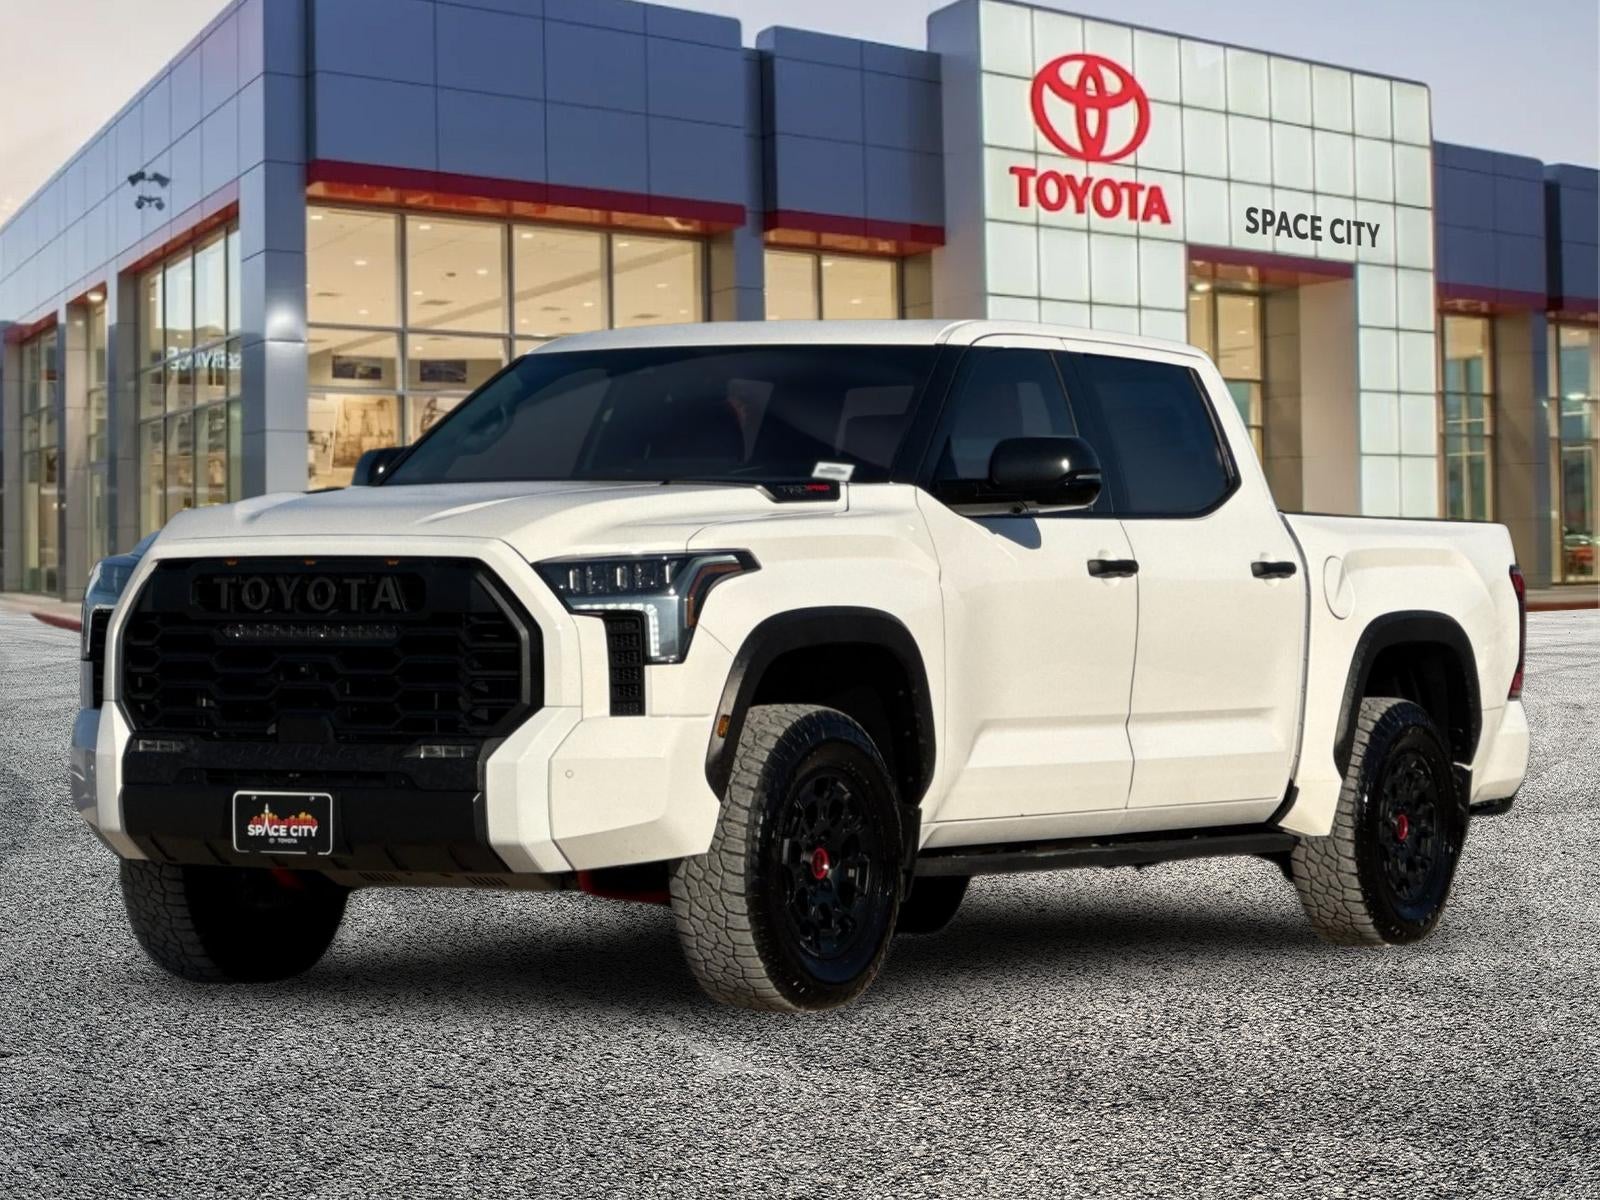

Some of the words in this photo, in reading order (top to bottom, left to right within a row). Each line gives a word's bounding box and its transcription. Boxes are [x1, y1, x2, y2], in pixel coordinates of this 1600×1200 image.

[1009, 166, 1171, 224] TOYOTA
[1245, 207, 1322, 242] SPACE
[1330, 218, 1380, 248] CITY
[213, 576, 402, 611] TOYOTA
[247, 824, 288, 837] SPACE
[289, 825, 318, 837] CITY
